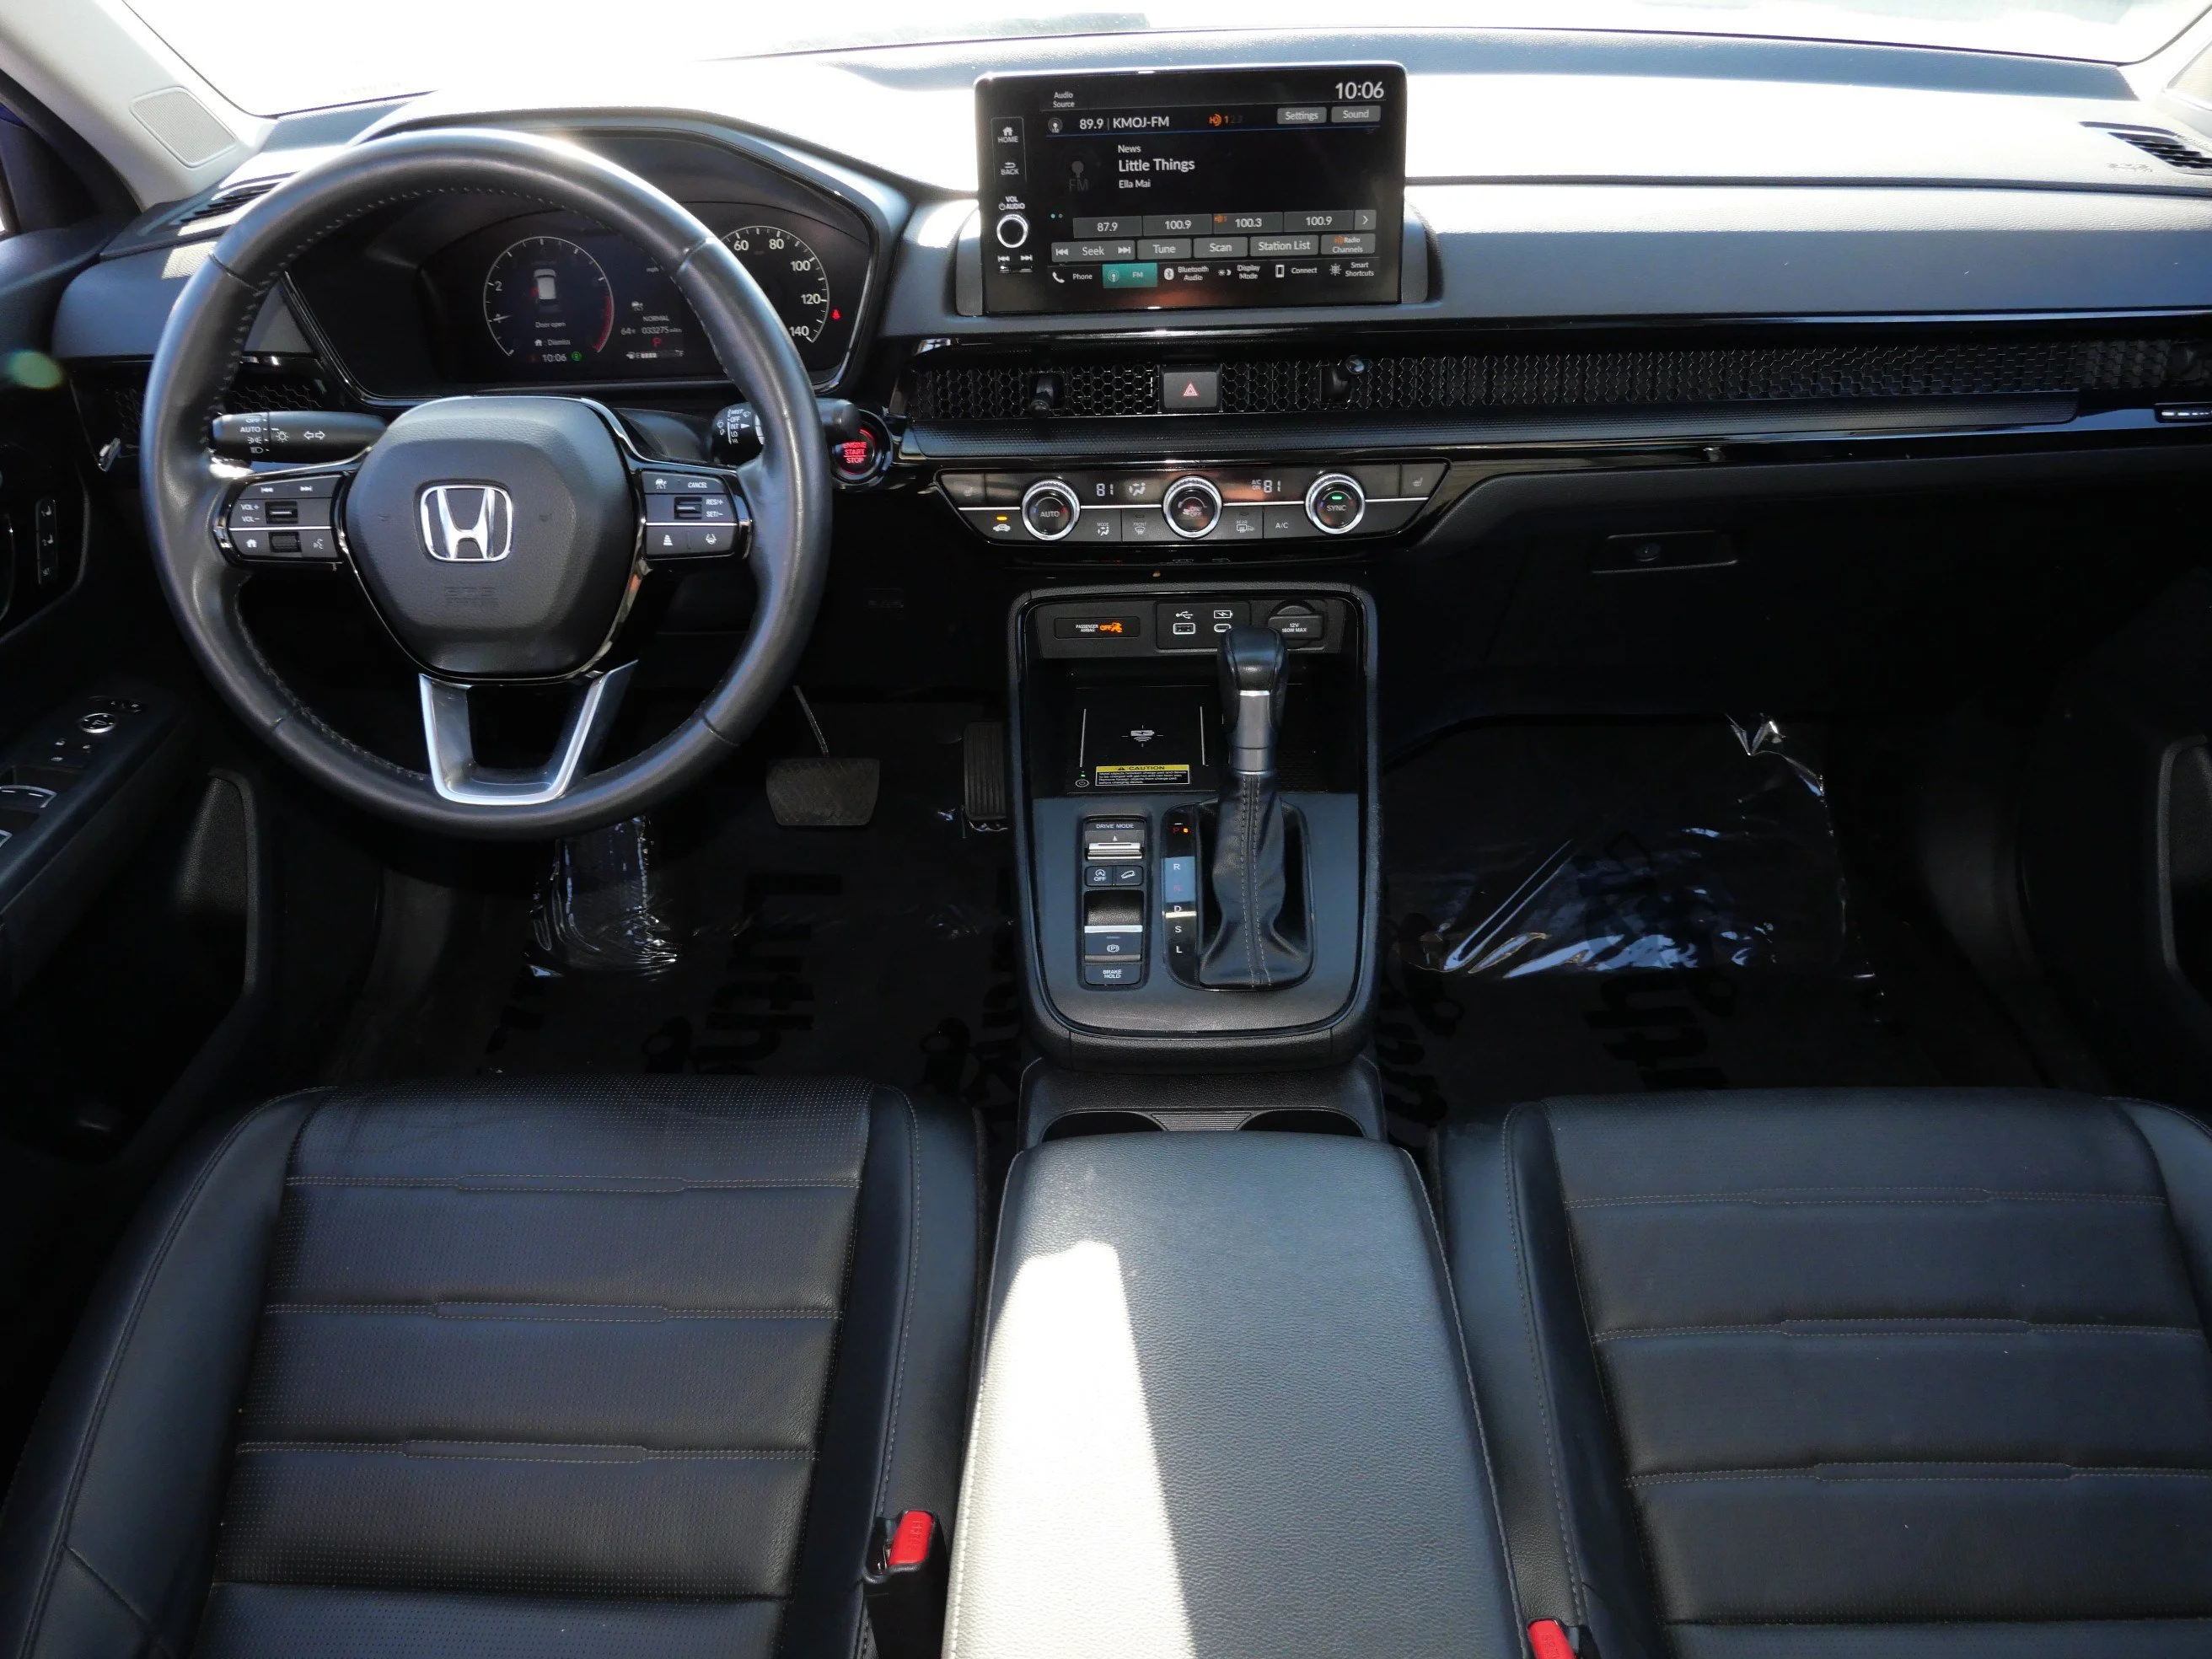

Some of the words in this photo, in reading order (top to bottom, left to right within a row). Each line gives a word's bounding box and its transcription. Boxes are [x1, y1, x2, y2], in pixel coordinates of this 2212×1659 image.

[1335, 82, 1385, 99] 10:06
[1285, 111, 1319, 121] Settings
[1342, 110, 1370, 119] Sound
[1079, 118, 1104, 130] 89.9
[1113, 116, 1170, 129] KMOJ-FM
[1118, 145, 1141, 153] News
[1118, 159, 1150, 173] Little
[1153, 158, 1195, 173] Things
[1119, 180, 1134, 189] Ella
[1135, 179, 1151, 188] Mai
[1164, 219, 1192, 230] 100.9
[1234, 217, 1263, 228] 100.3
[1306, 216, 1333, 226] 100.9
[1097, 222, 1119, 233] 87.9
[733, 240, 749, 251] 60
[769, 239, 785, 250] 80
[1152, 244, 1177, 254] Tune
[1209, 243, 1232, 252] Scan
[1258, 242, 1291, 251] Station
[1294, 241, 1312, 250] List
[1082, 247, 1105, 256] Seek
[791, 260, 811, 271] 100
[1237, 265, 1261, 273] Display
[1072, 272, 1093, 281] Phone
[494, 281, 502, 292] 2
[801, 293, 821, 304] 120
[789, 325, 810, 336] 140
[542, 353, 567, 362] 10:06
[1095, 483, 1114, 497] 81
[1263, 479, 1281, 493] 81
[1175, 945, 1183, 953] L
